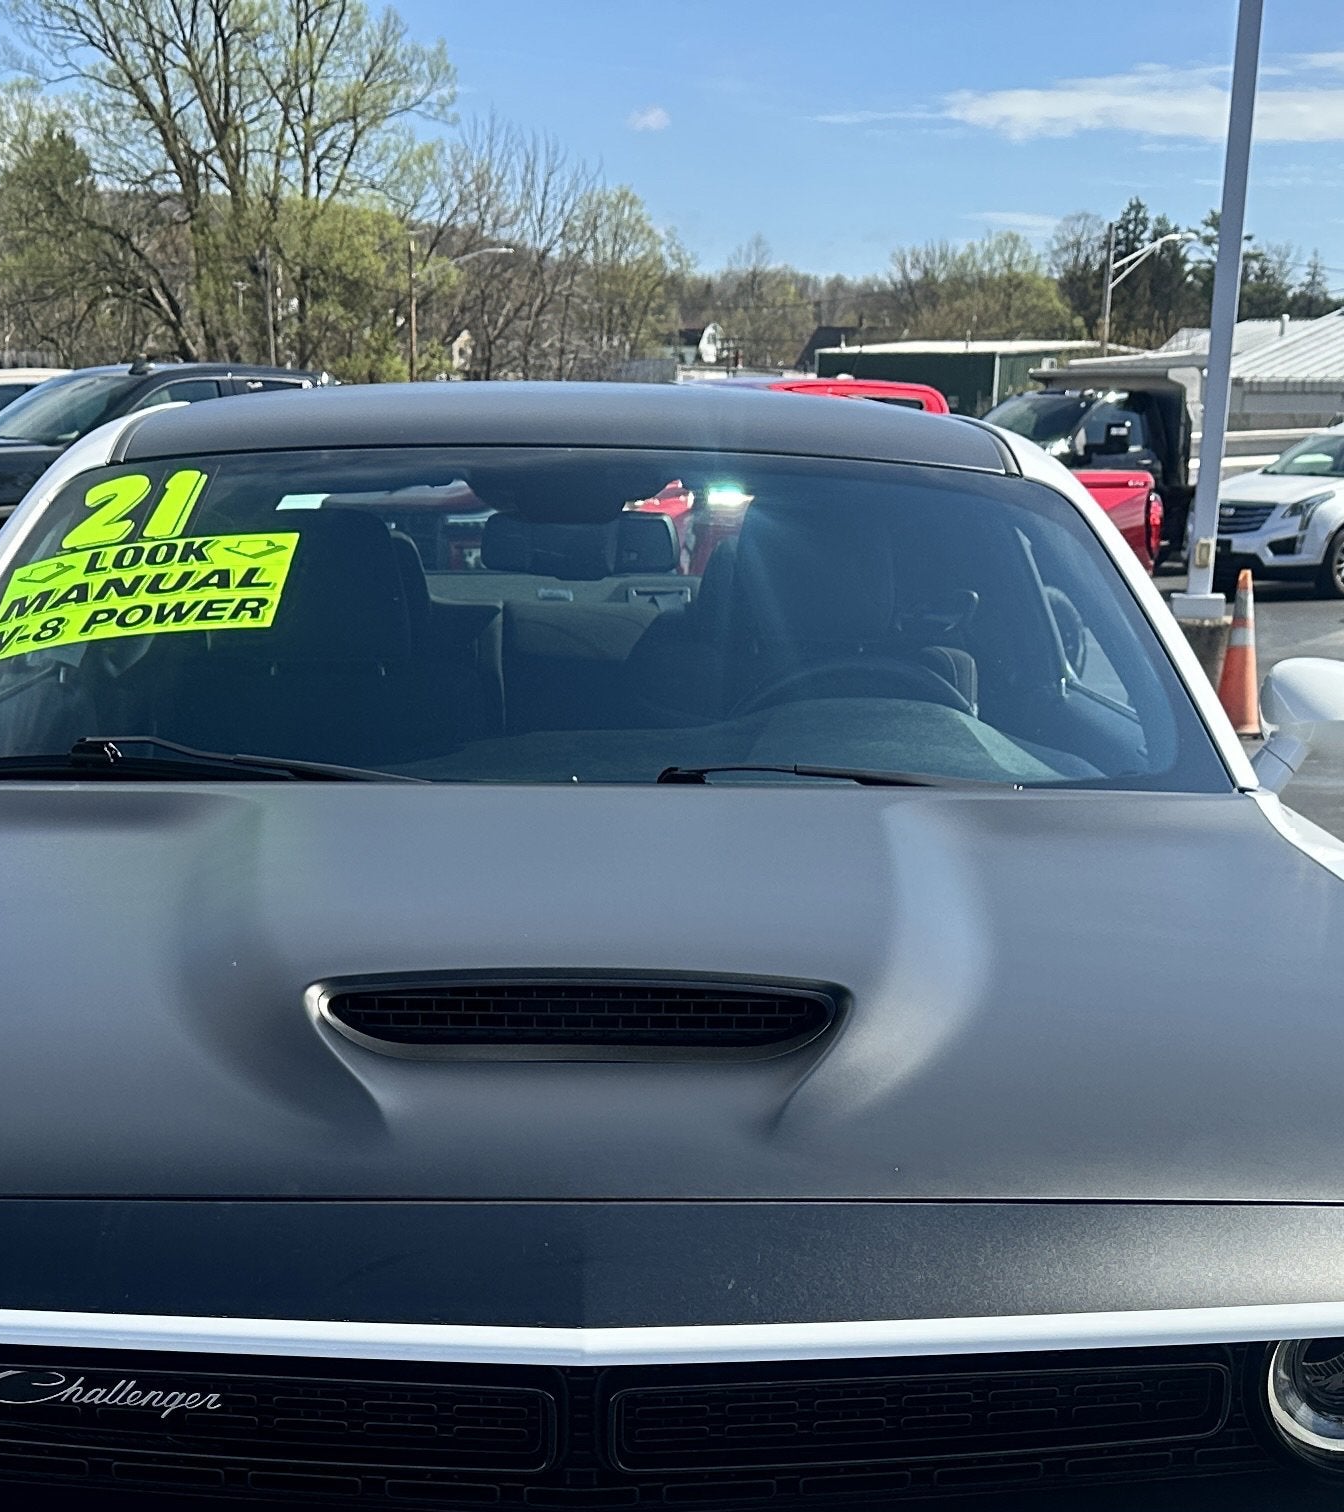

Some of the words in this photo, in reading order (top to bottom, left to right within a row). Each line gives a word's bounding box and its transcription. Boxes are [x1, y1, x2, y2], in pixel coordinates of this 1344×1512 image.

[62, 470, 208, 550] 21
[83, 540, 219, 576] LOOK
[78, 596, 272, 637] POWER
